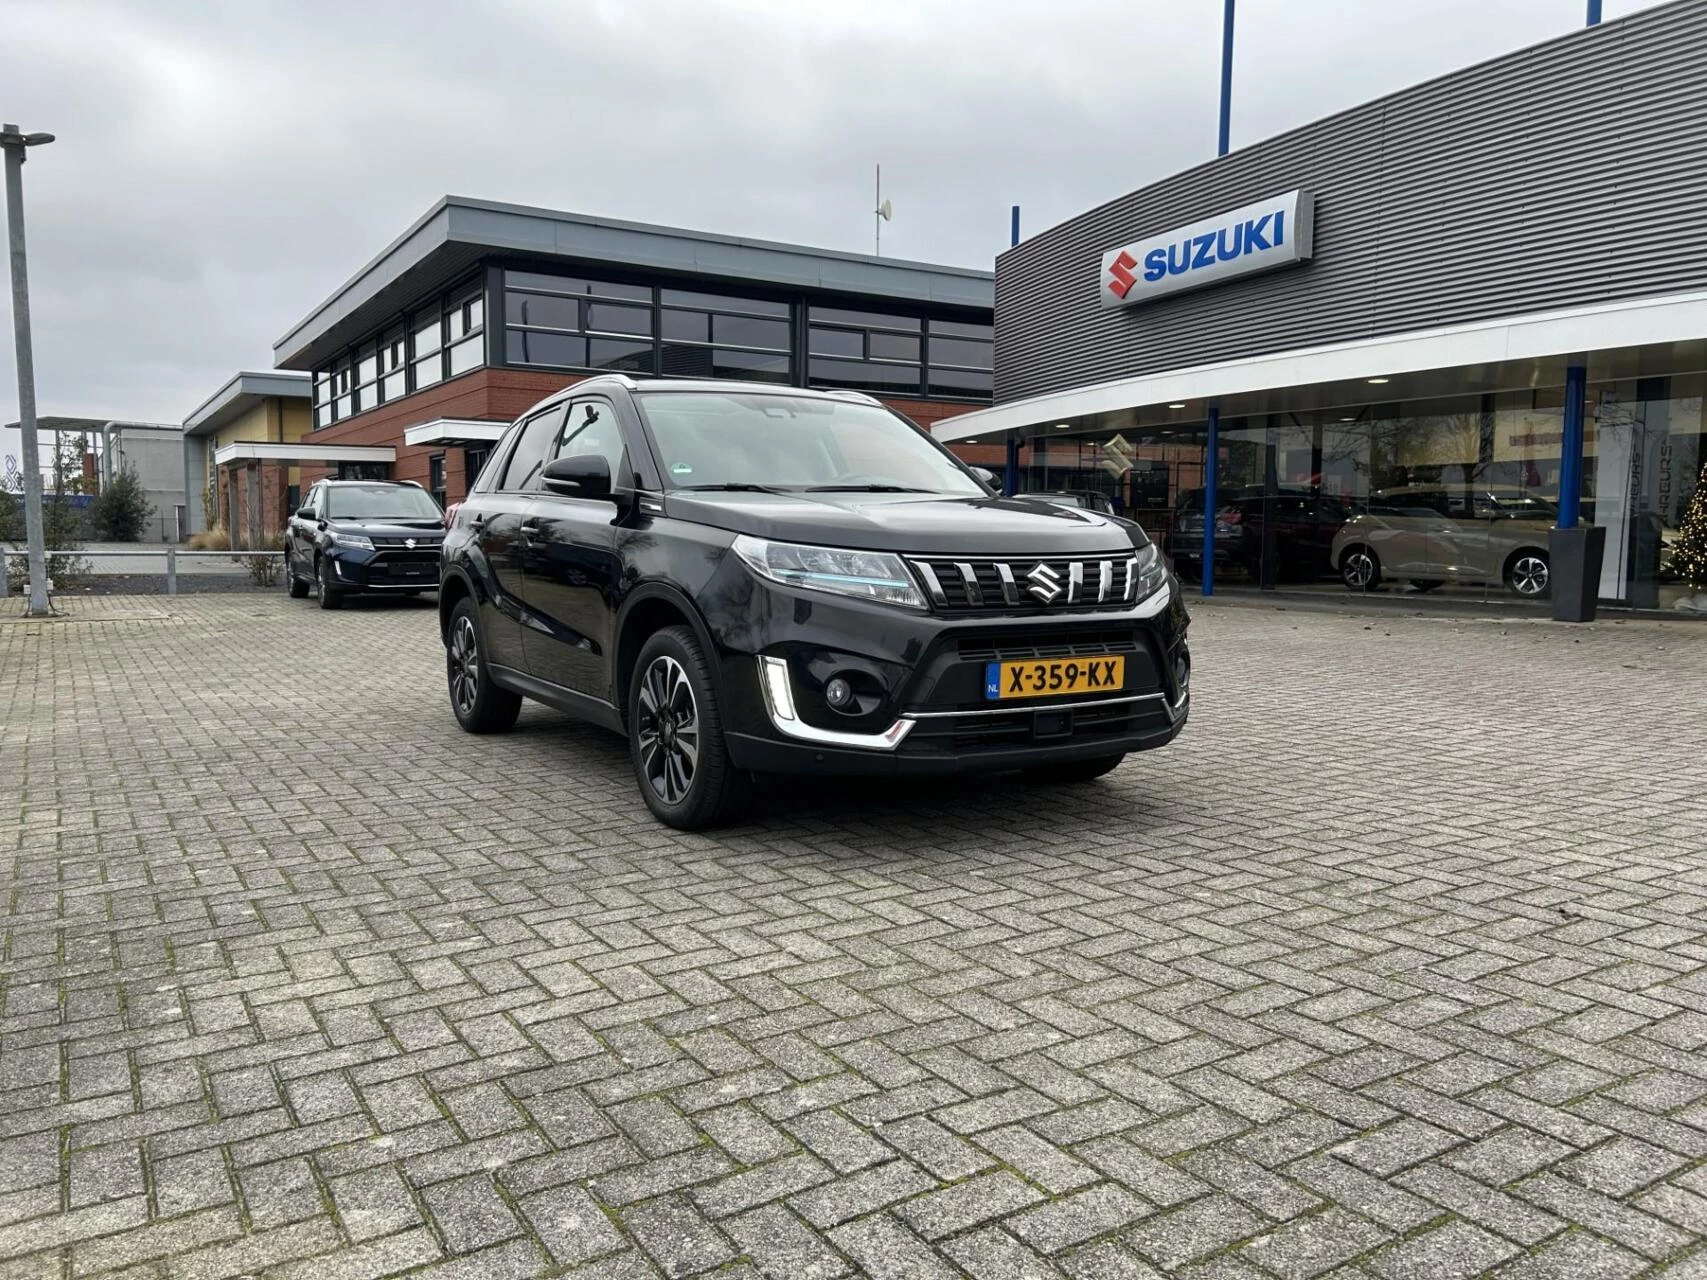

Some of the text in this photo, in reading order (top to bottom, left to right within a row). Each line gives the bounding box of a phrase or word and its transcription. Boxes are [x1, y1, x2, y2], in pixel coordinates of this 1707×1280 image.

[1143, 210, 1285, 282] SUZUKI
[987, 684, 999, 693] NL
[1009, 660, 1117, 693] X-359-KX
